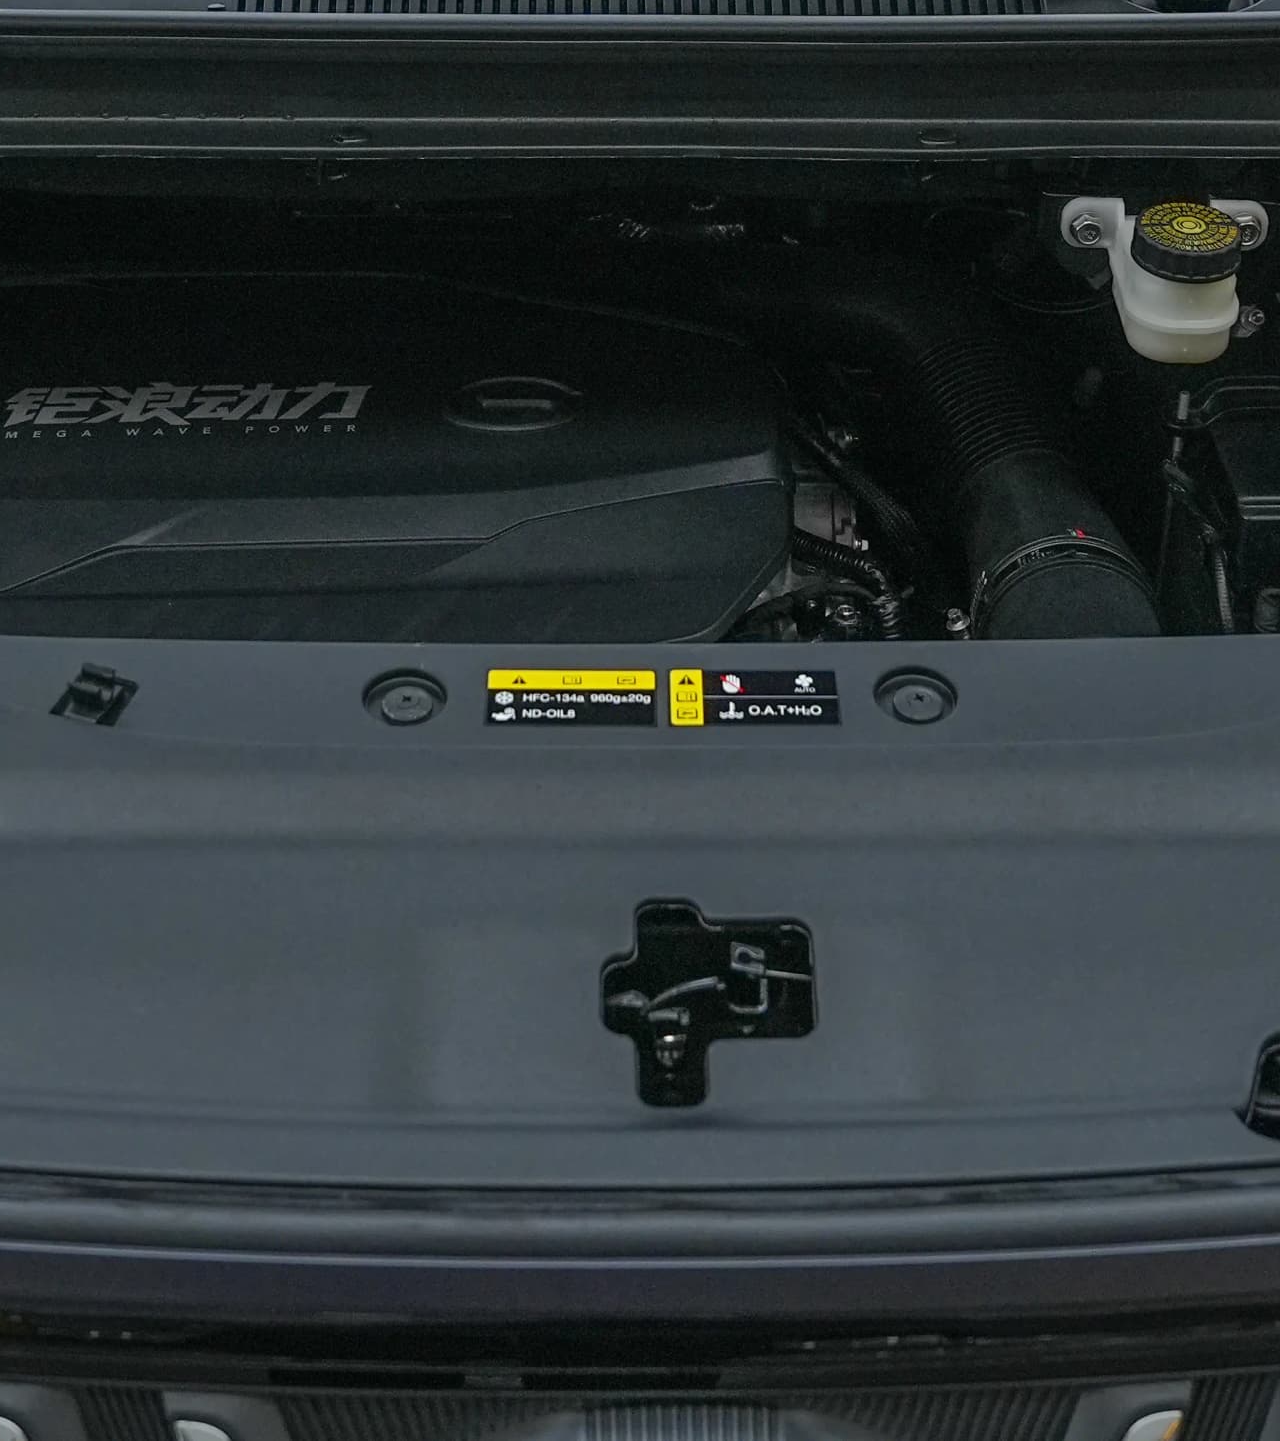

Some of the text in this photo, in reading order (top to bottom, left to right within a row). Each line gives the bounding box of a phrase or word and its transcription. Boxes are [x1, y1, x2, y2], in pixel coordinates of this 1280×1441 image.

[3, 381, 373, 428] 钜浪动力
[4, 424, 357, 439] MEGA WAVE POWER
[522, 692, 585, 703] HFC-134a
[521, 708, 576, 719] ND-OIL8
